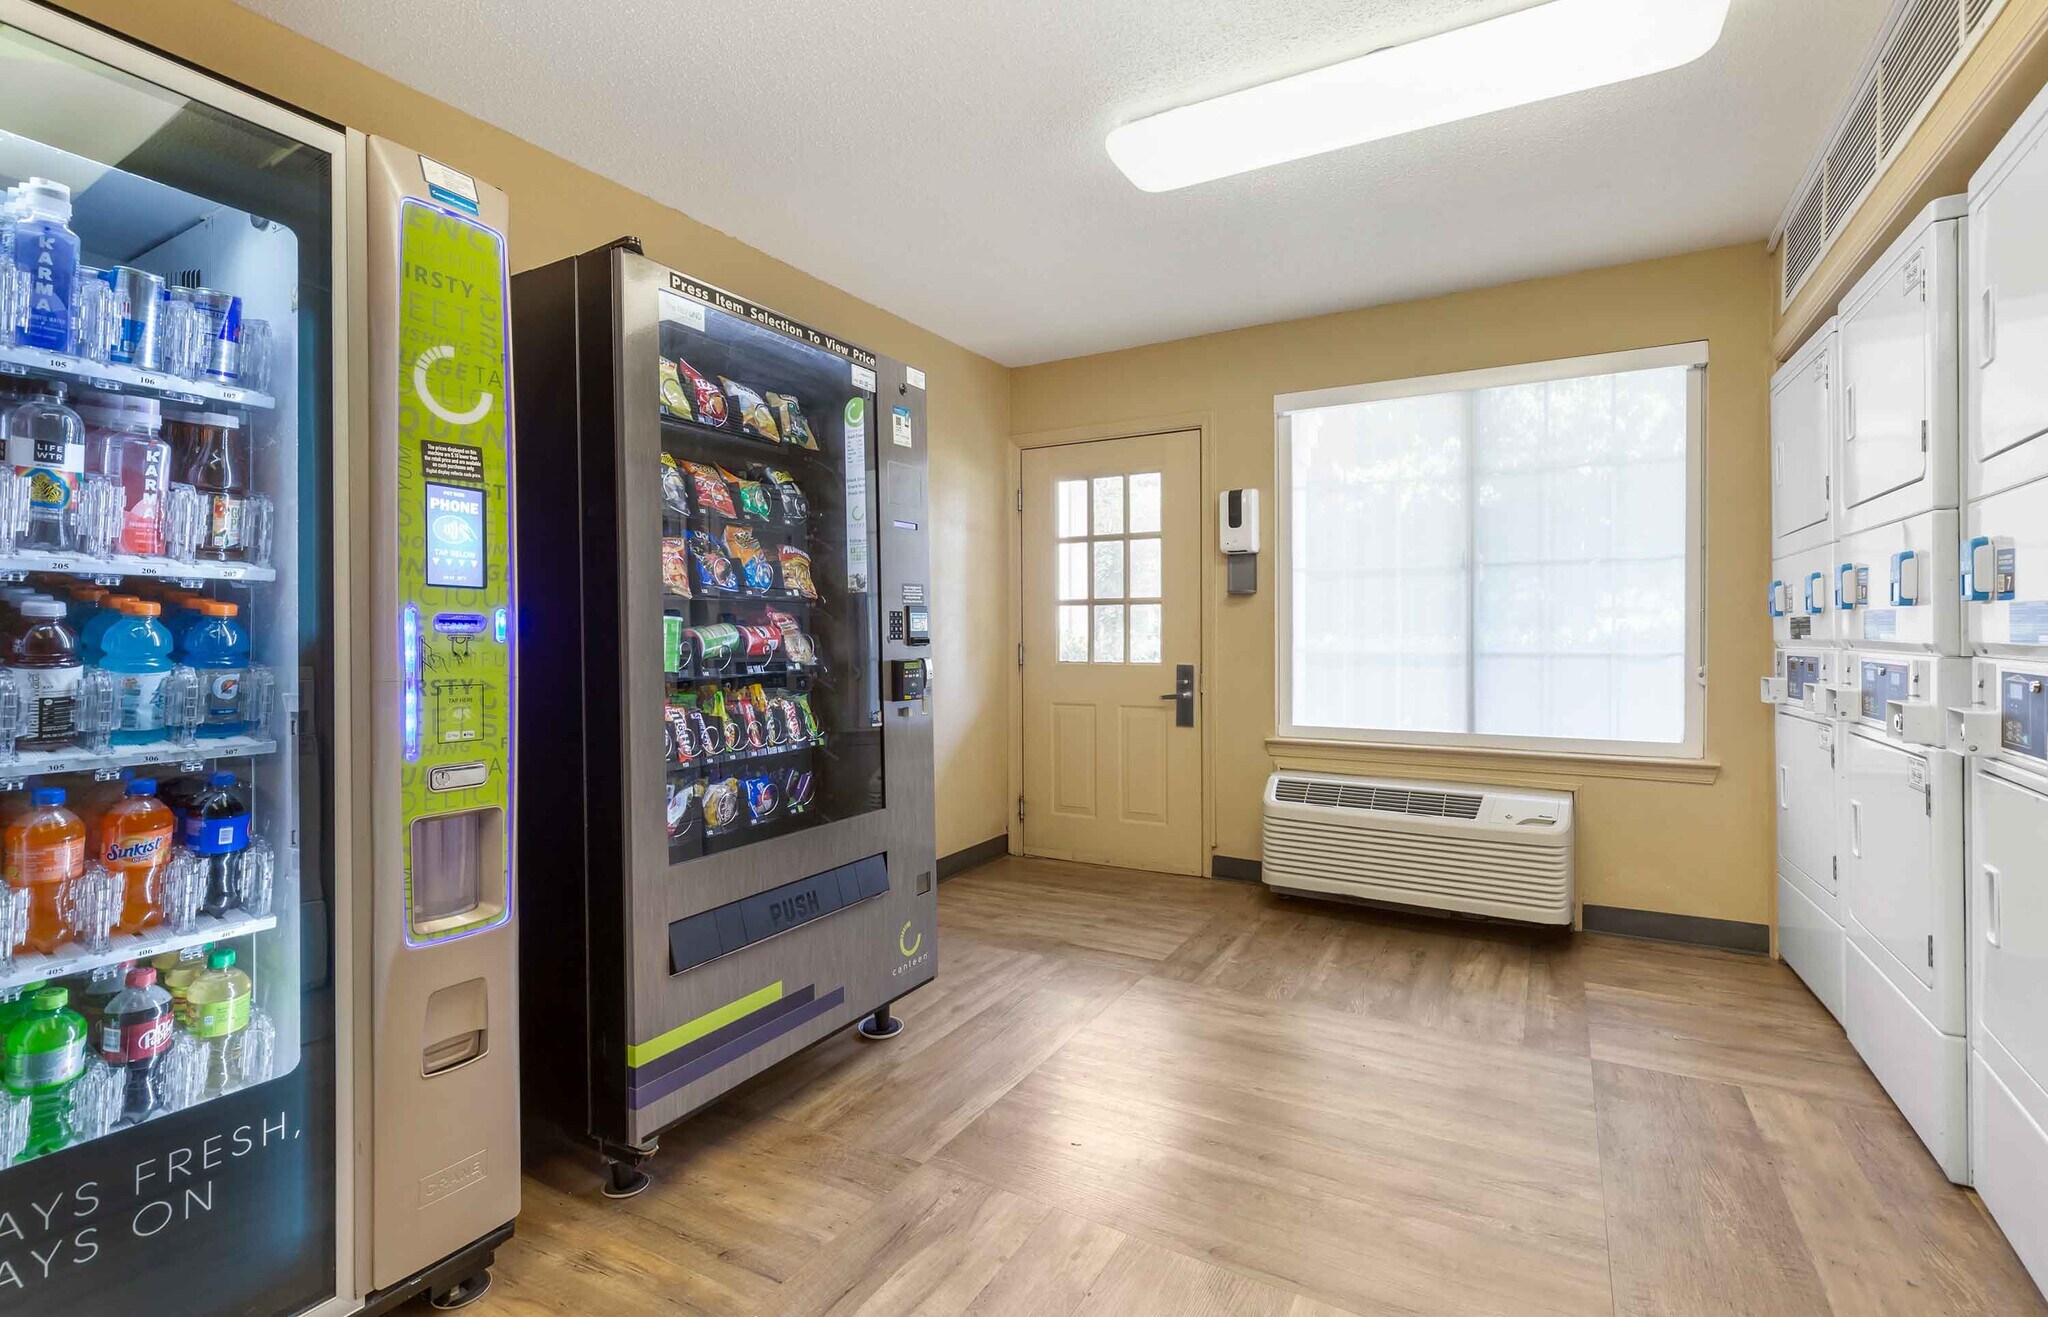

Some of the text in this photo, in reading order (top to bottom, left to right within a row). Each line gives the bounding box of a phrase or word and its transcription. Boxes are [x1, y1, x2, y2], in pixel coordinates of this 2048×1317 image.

[35, 235, 55, 311] KARMA
[672, 275, 876, 367] Press Item Selection To View Price
[50, 359, 67, 369] 105
[140, 376, 155, 385] 106
[37, 443, 63, 452] LIFE
[37, 452, 63, 460] WTR
[142, 450, 160, 519] KARMA
[430, 497, 479, 515] PHONE
[52, 562, 69, 570] 205
[142, 567, 157, 575] 206
[47, 764, 65, 772] 305
[107, 837, 162, 861] Sunkist
[769, 890, 820, 925] PUSH
[137, 949, 153, 957] 406
[46, 967, 64, 976] 405
[892, 953, 928, 976] canteen
[136, 1111, 301, 1195] FRESH,
[132, 1181, 212, 1237] ON
